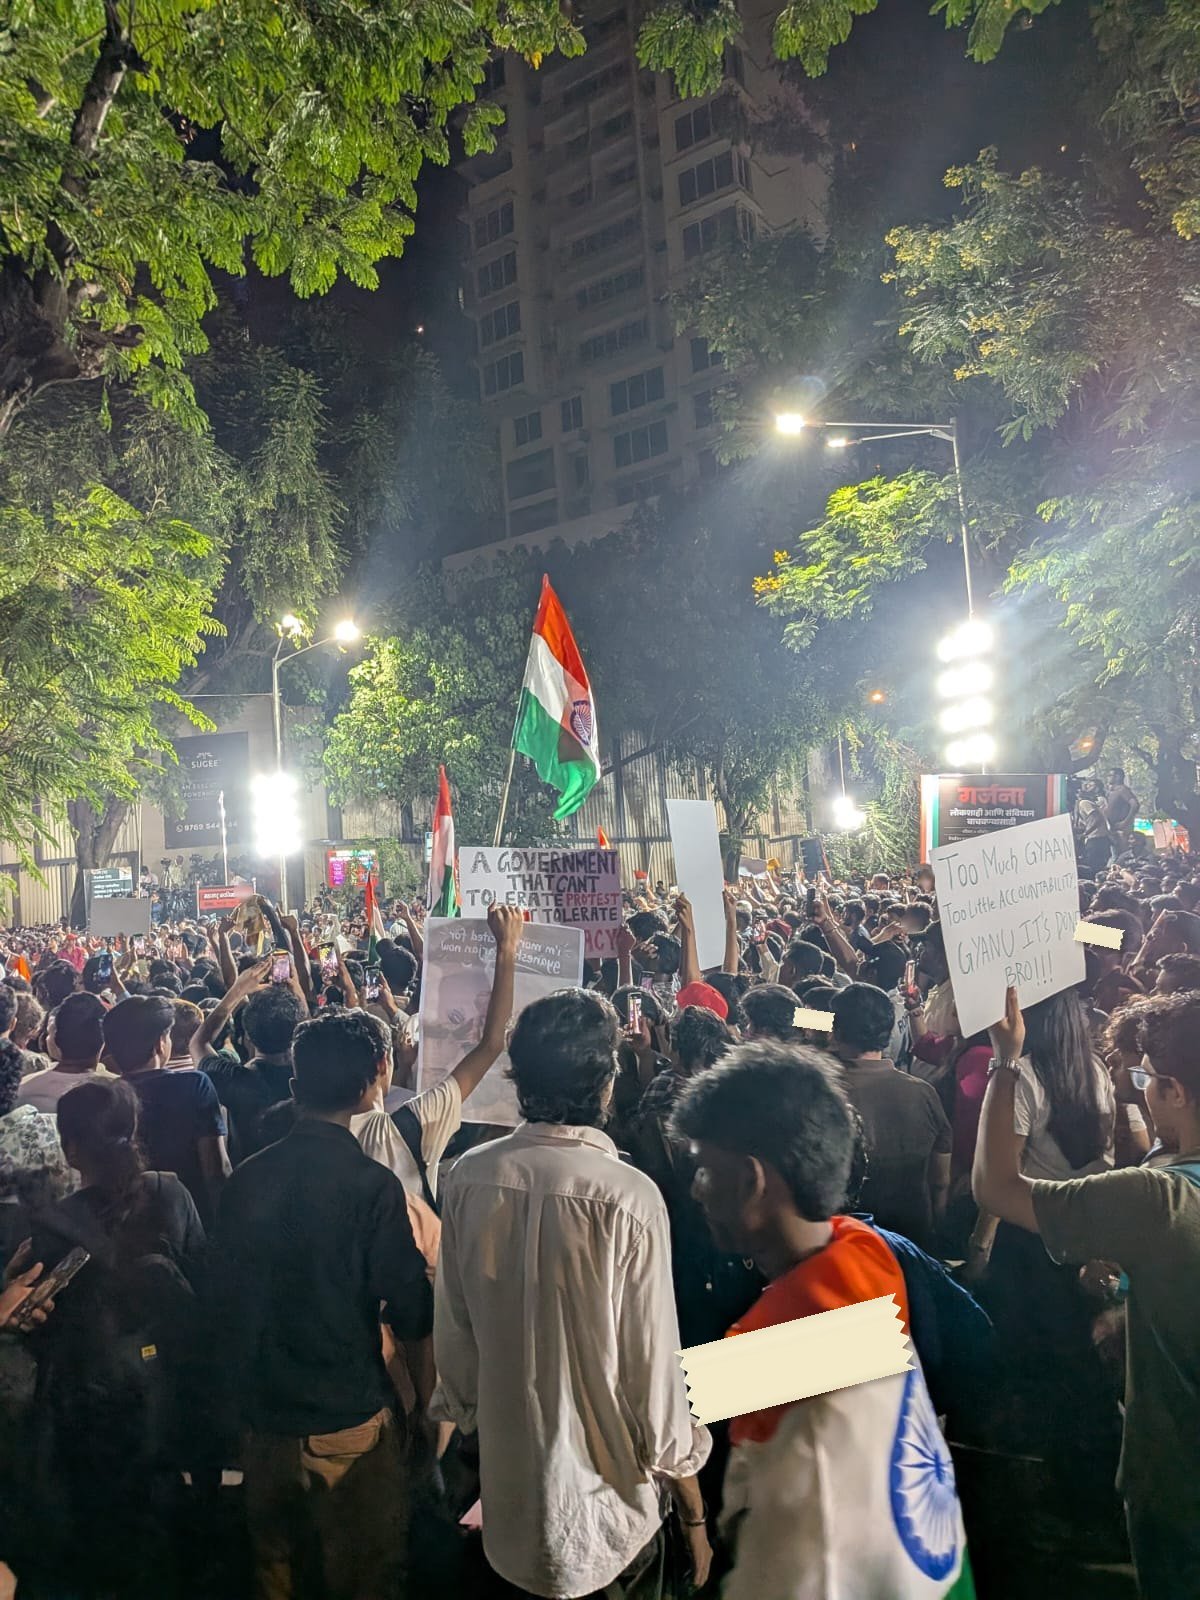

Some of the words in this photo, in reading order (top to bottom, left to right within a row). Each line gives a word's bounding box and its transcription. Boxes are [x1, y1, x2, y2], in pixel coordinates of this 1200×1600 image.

[191, 759, 219, 769] SUGEE
[957, 784, 1026, 806] गर्जना
[471, 851, 492, 874] A
[497, 851, 618, 875] GOVERNMENT
[1025, 838, 1073, 866] GYAAN
[507, 874, 555, 892] THAT
[466, 889, 563, 907] TOLERATE
[565, 893, 620, 907] PROTEST
[543, 907, 618, 923] TOLERATE
[958, 928, 1015, 975] GYANU
[1004, 950, 1053, 987] BRO!!!
